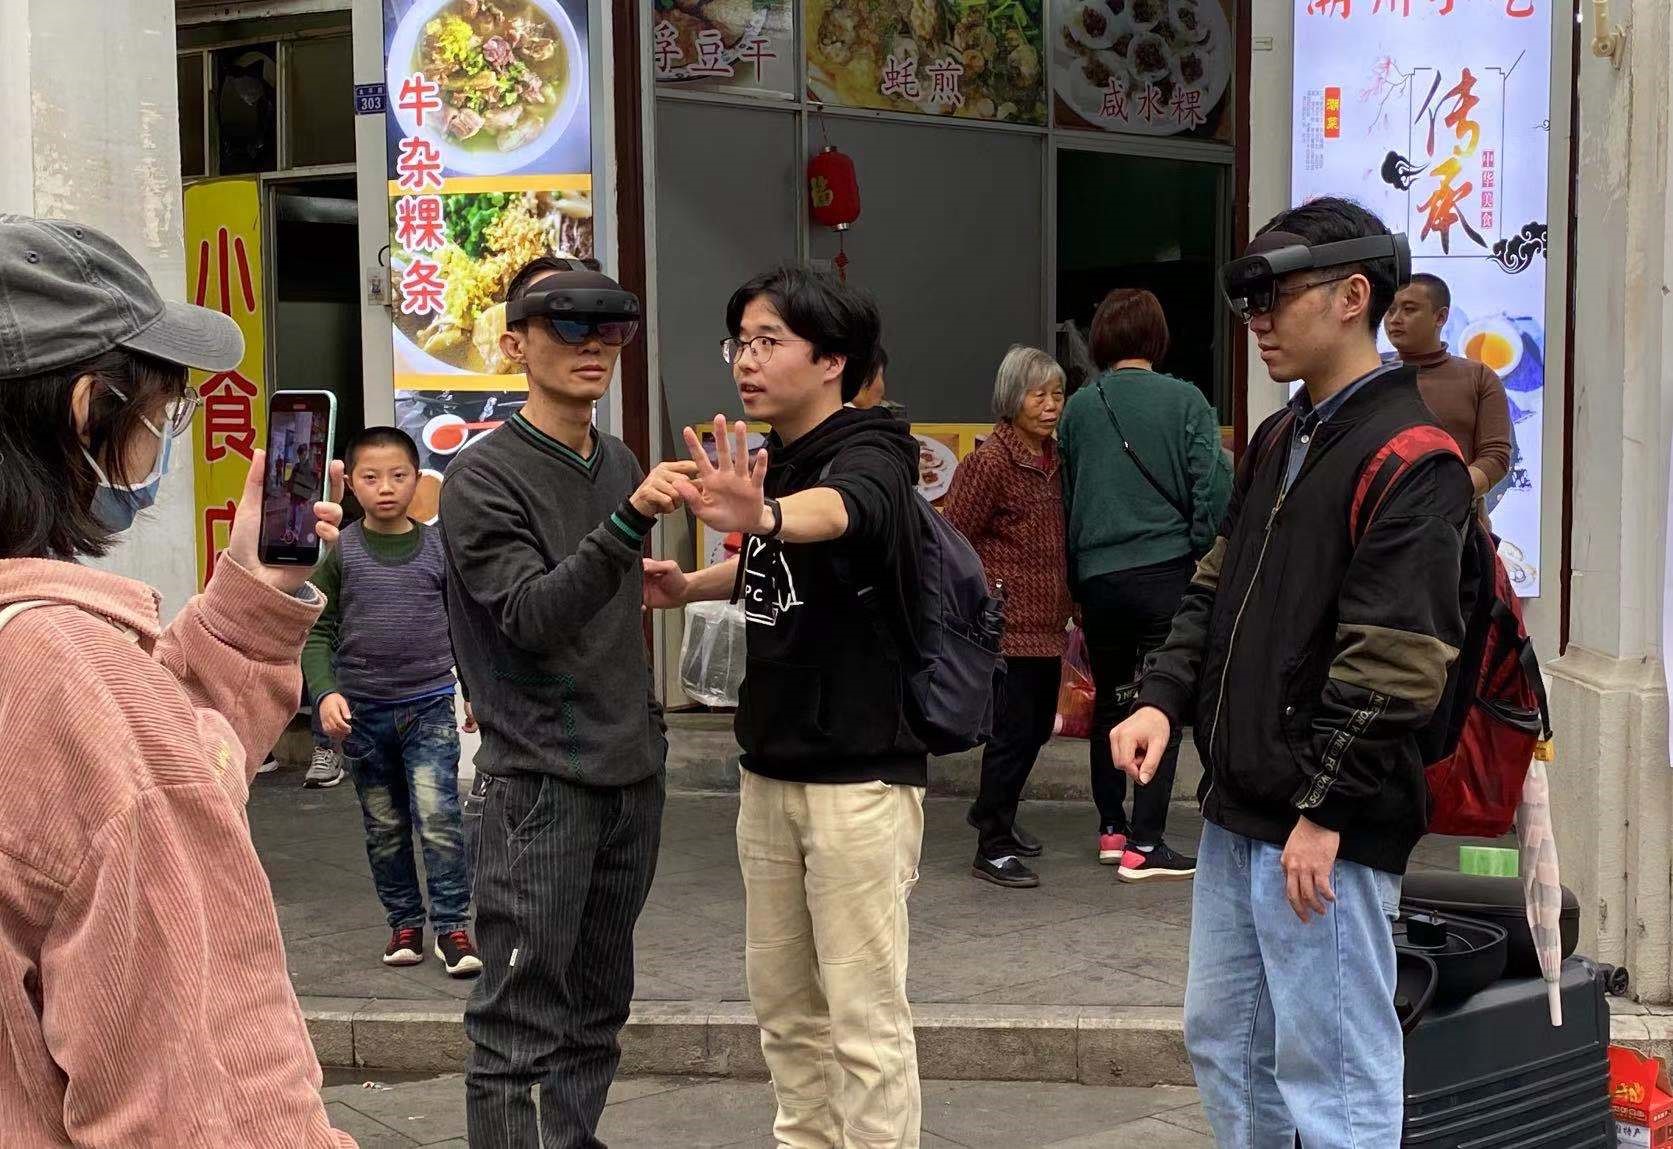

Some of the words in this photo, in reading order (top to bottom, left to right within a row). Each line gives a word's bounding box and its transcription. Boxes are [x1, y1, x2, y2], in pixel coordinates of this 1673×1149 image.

[361, 97, 381, 110] 303
[883, 57, 964, 103] 蚝煎
[1101, 86, 1206, 127] 咸水粿
[1414, 67, 1488, 255] 传承
[1481, 150, 1495, 229] 中华美食
[399, 76, 445, 313] 牛杂粿条
